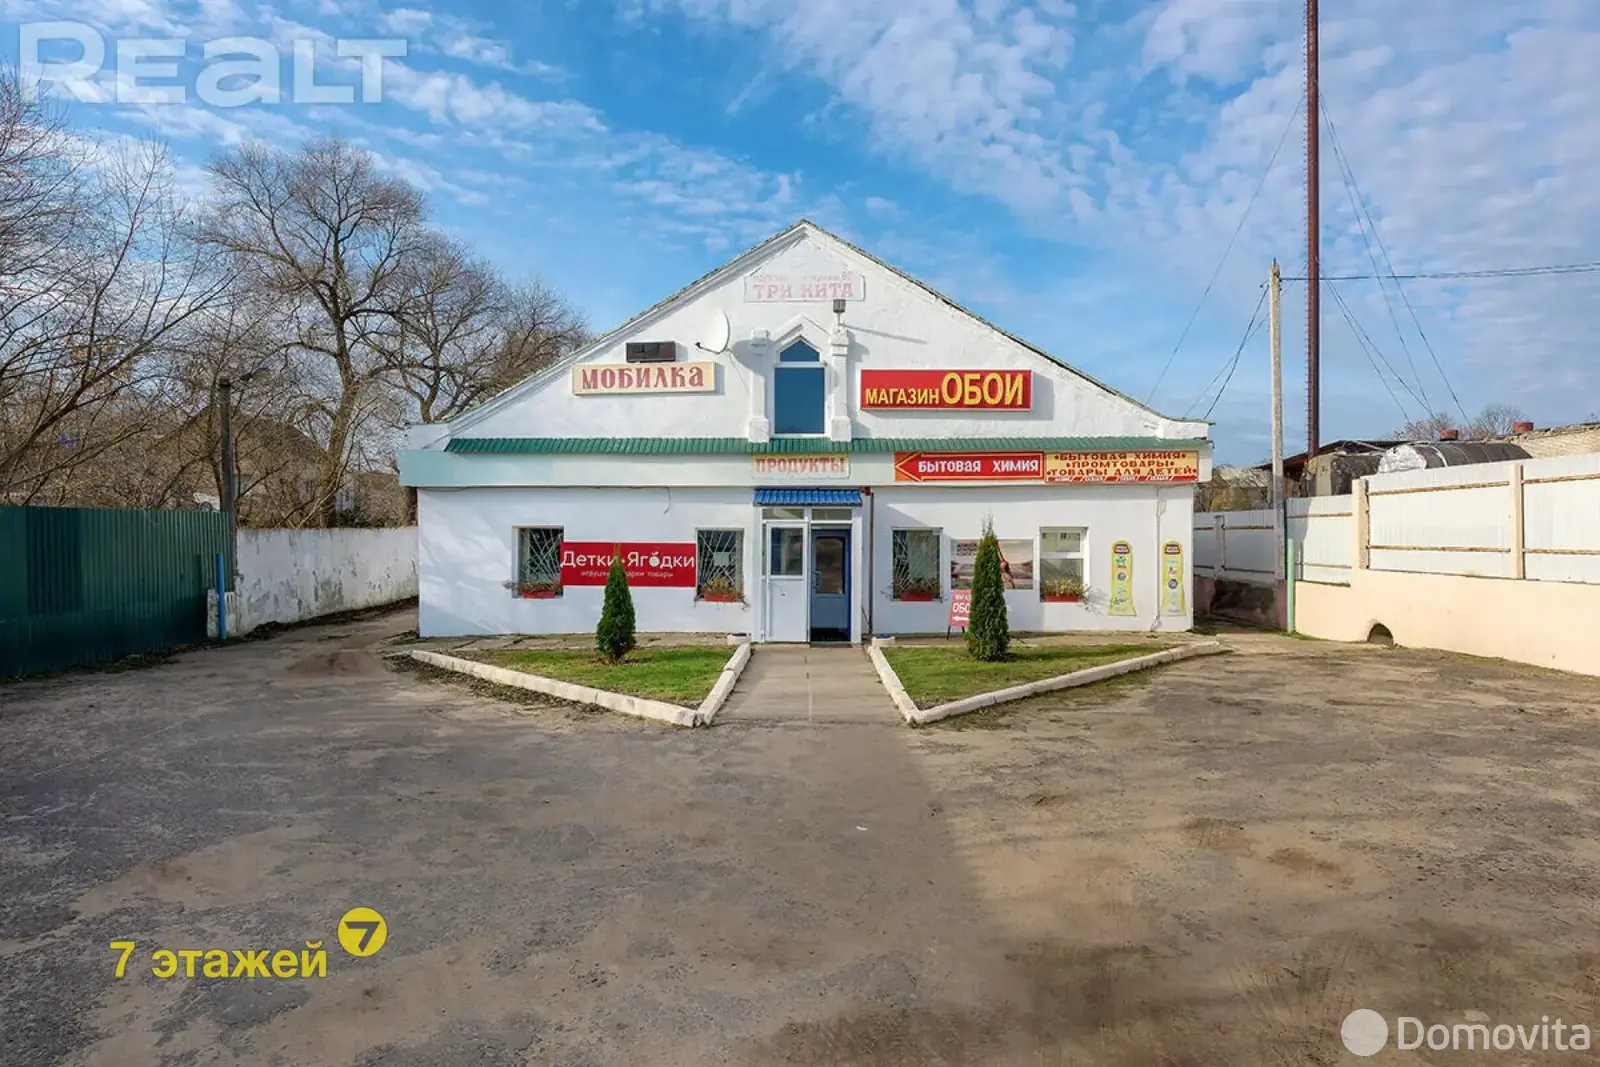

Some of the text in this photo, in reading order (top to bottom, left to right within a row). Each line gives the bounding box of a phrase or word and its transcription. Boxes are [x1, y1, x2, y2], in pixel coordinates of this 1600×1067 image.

[753, 281, 854, 299] ТРИ КИТА
[865, 372, 1024, 405] МАГАЗИН ОБОИ
[1059, 452, 1181, 461] БЫТОВАЯ ХИМИЯ
[755, 456, 845, 475] ПРОДУКТЫ
[992, 459, 1039, 472] ХИМИЯ
[1051, 465, 1193, 477] ТОВАРЫ ДЛЯ ДЕТЕЙ
[1071, 460, 1169, 469] ПРОМТОВАРЫ
